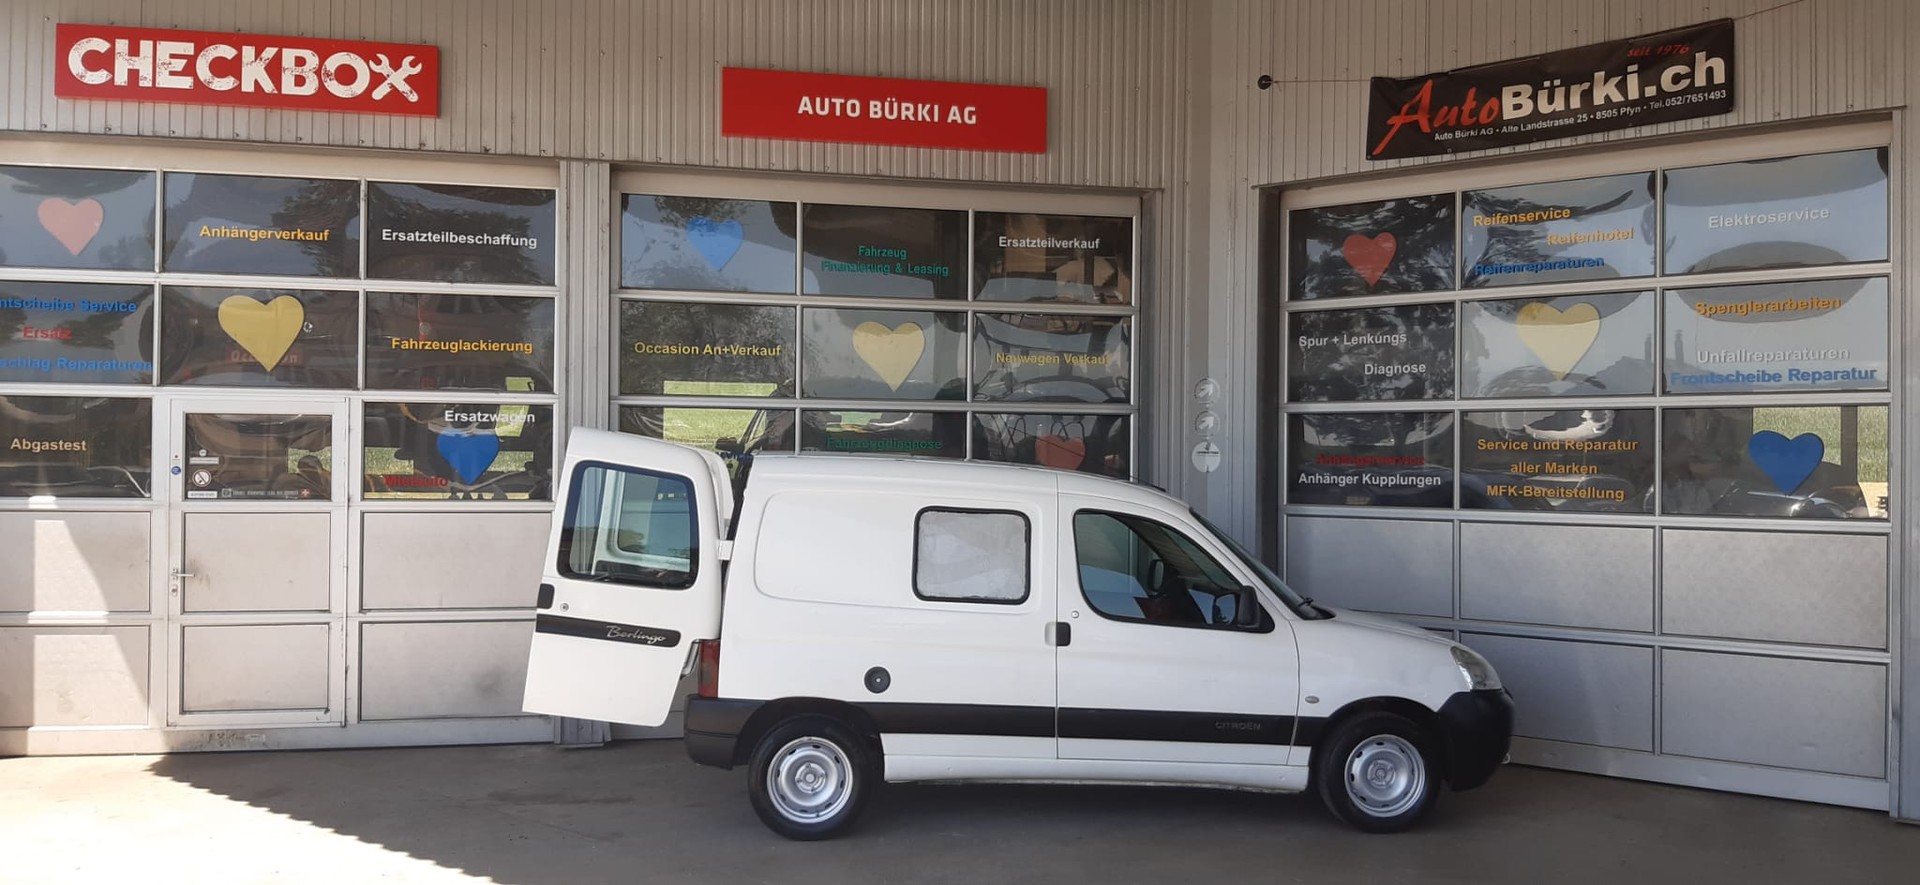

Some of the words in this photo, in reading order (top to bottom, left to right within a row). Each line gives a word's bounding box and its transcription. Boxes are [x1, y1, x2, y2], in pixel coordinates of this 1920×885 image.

[1656, 44, 1691, 55] 1976
[797, 96, 861, 117] AUTO
[869, 97, 939, 122] BÜRKI
[947, 105, 977, 125] AG
[1434, 131, 1453, 141] Auto
[1455, 128, 1478, 139] Bürki
[1480, 127, 1494, 136] AG
[1501, 124, 1518, 133] Alte
[1521, 116, 1575, 132] Landstrasse
[1576, 113, 1589, 123] 25
[1596, 108, 1619, 120] 8505
[1620, 105, 1641, 116] Pfyn
[1473, 207, 1571, 227] Reifenservice
[1708, 207, 1831, 229] Elektroservice
[199, 225, 330, 243] Anhängerverkauf
[381, 228, 538, 249] Ersatzteilbeschaffung
[998, 235, 1101, 250] Ersatzteilverkauf
[1547, 227, 1634, 246] Reifenhotel
[858, 245, 907, 260] Fahrzeug
[895, 262, 903, 274] &
[907, 263, 950, 277] Leasing
[1474, 257, 1605, 276] Reifenreparaturen
[80, 298, 137, 313] Service
[1695, 297, 1842, 318] Spenglerarbeiten
[22, 325, 73, 340] Ersatz
[1299, 335, 1329, 349] Spur
[1343, 331, 1407, 347] Lenkungs
[391, 337, 533, 354] Fahrzeuglackierung
[634, 341, 699, 355] Occasion
[703, 343, 782, 357] An+Verkauf
[996, 352, 1060, 366] Neuwagen
[1064, 353, 1112, 365] Verkauf
[1697, 346, 1850, 364] Unfallreparaturen
[57, 357, 152, 372] Reparaturen
[1364, 361, 1426, 377] Diagnose
[1670, 369, 1783, 385] Frontscheibe
[1787, 367, 1877, 384] Reparatur
[444, 409, 536, 425] Ersatzwagen
[10, 437, 88, 453] Abgastest
[1477, 438, 1529, 451] Service
[1533, 438, 1560, 451] und
[1564, 438, 1638, 455] Reparatur
[1510, 461, 1541, 474] aller
[1545, 461, 1598, 475] Marken
[1298, 472, 1360, 487] Anhänger
[1362, 473, 1442, 488] Kupplungen
[1486, 484, 1625, 502] MFK-Bereitstellung
[605, 625, 667, 644] Berlingo
